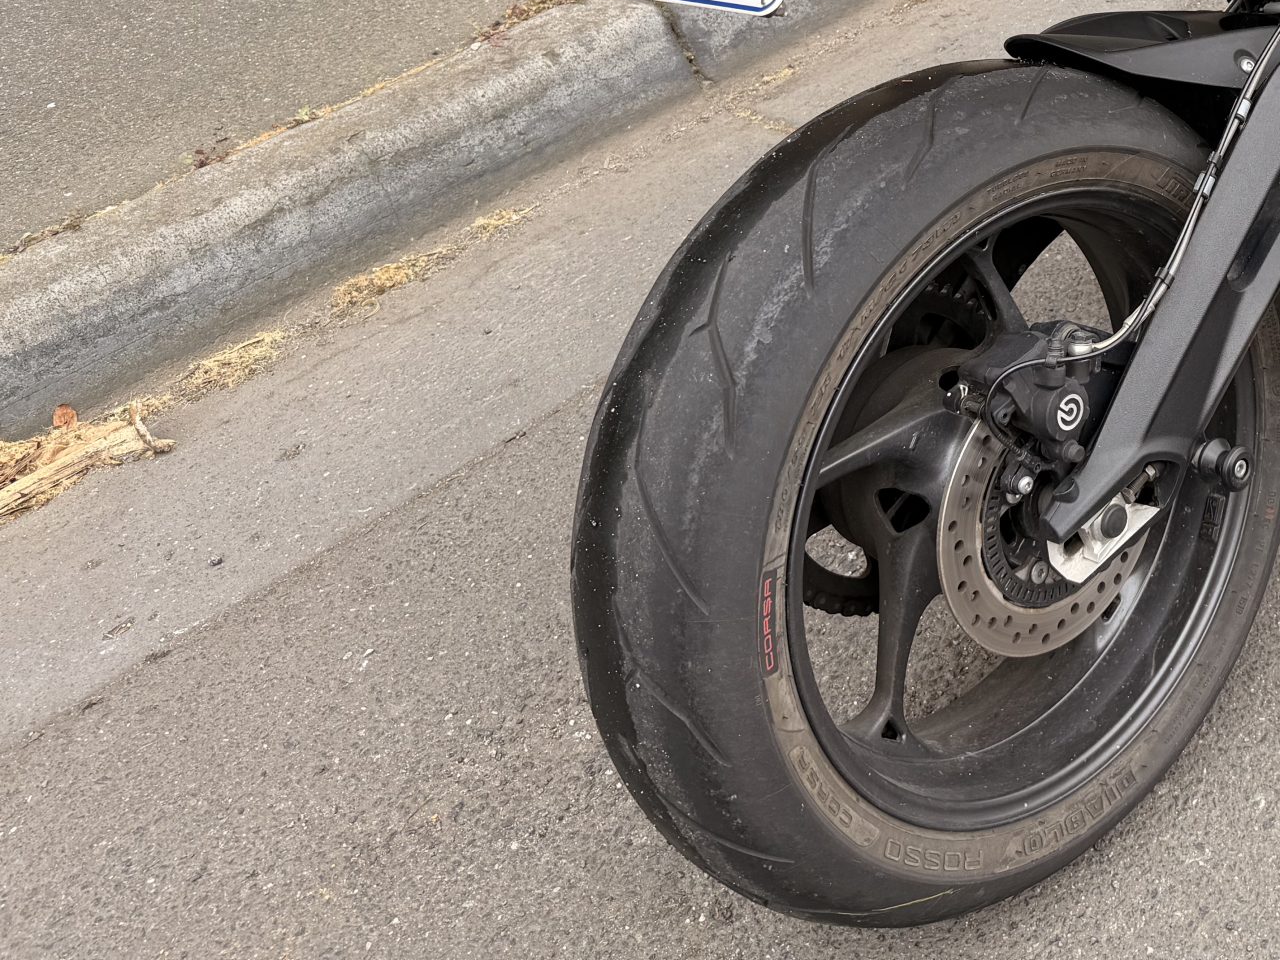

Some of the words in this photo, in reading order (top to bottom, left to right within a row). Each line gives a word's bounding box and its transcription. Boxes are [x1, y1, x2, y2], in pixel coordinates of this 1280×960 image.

[763, 578, 774, 671] CORSA
[797, 738, 854, 829] CORSA
[884, 838, 984, 871] ROSSO
